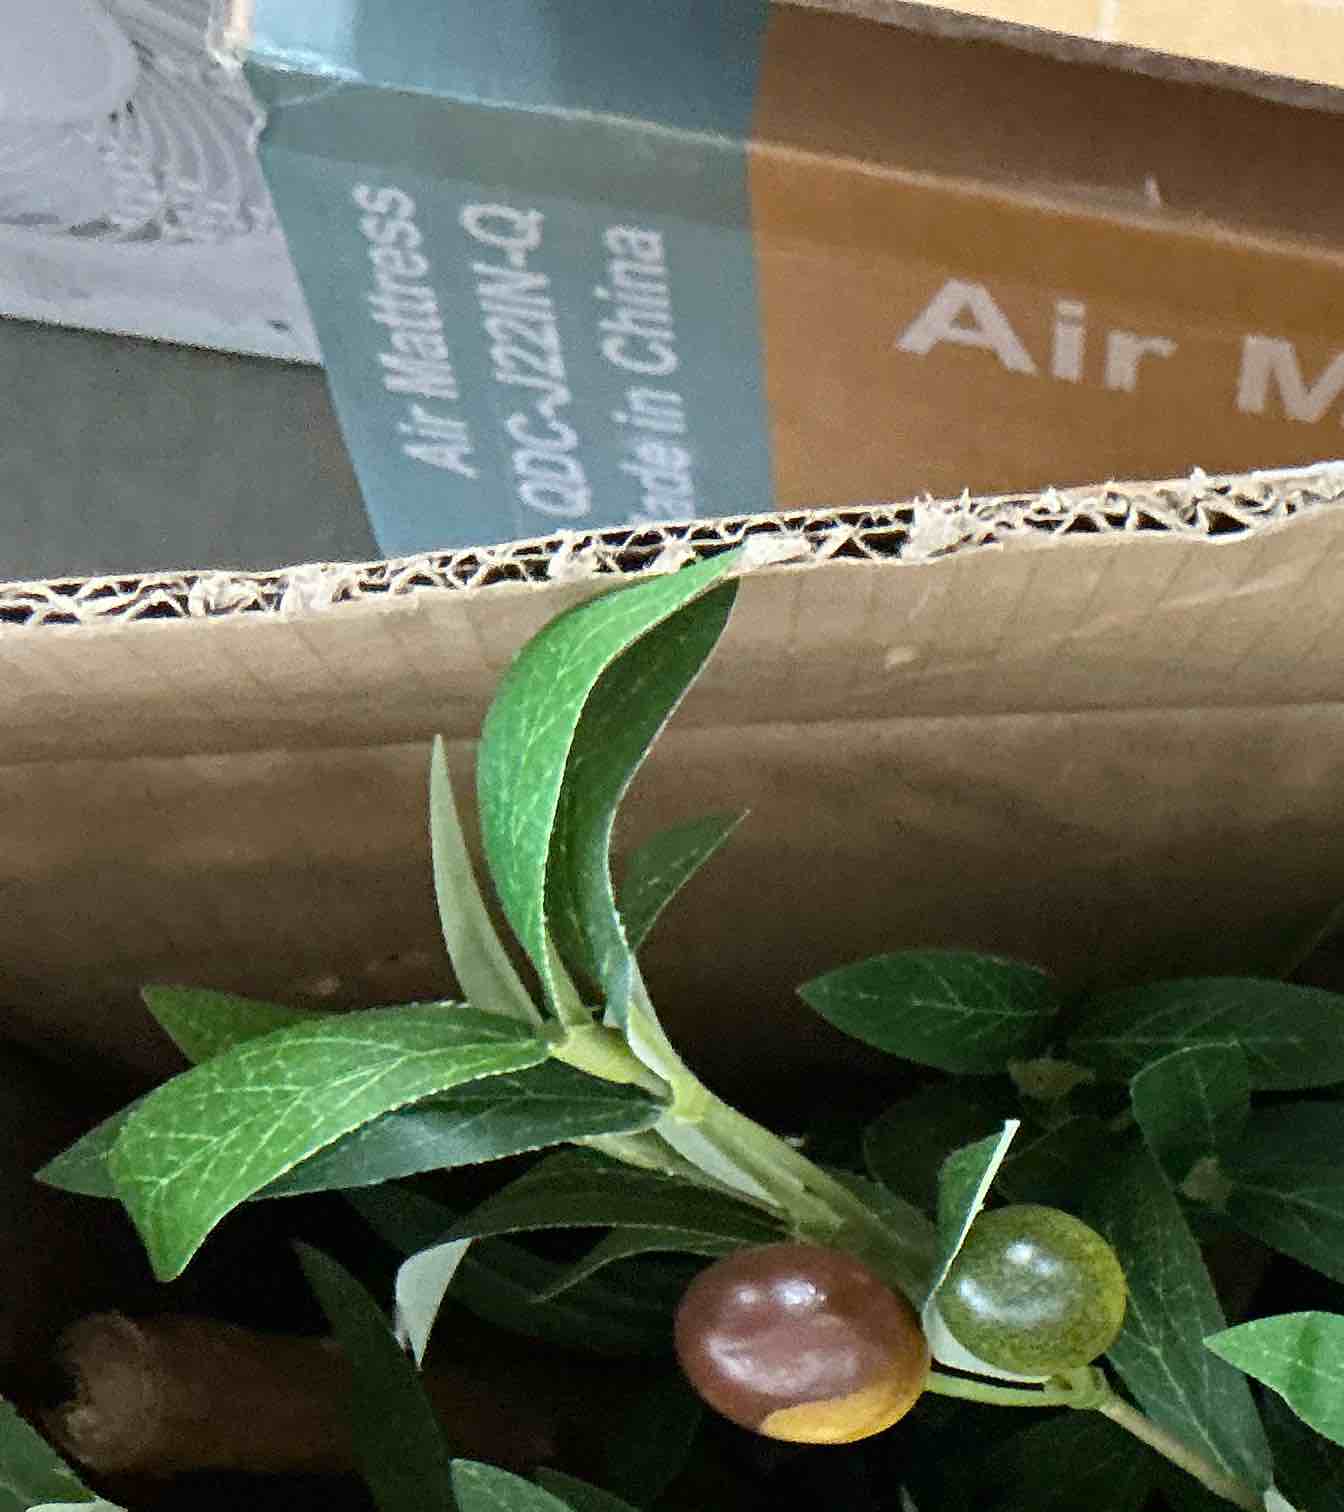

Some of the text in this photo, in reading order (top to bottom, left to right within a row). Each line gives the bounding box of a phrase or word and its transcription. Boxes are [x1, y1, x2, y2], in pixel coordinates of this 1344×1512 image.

[352, 183, 479, 480] Air Mattress
[593, 223, 698, 526] ade in China
[895, 277, 1179, 393] Air
